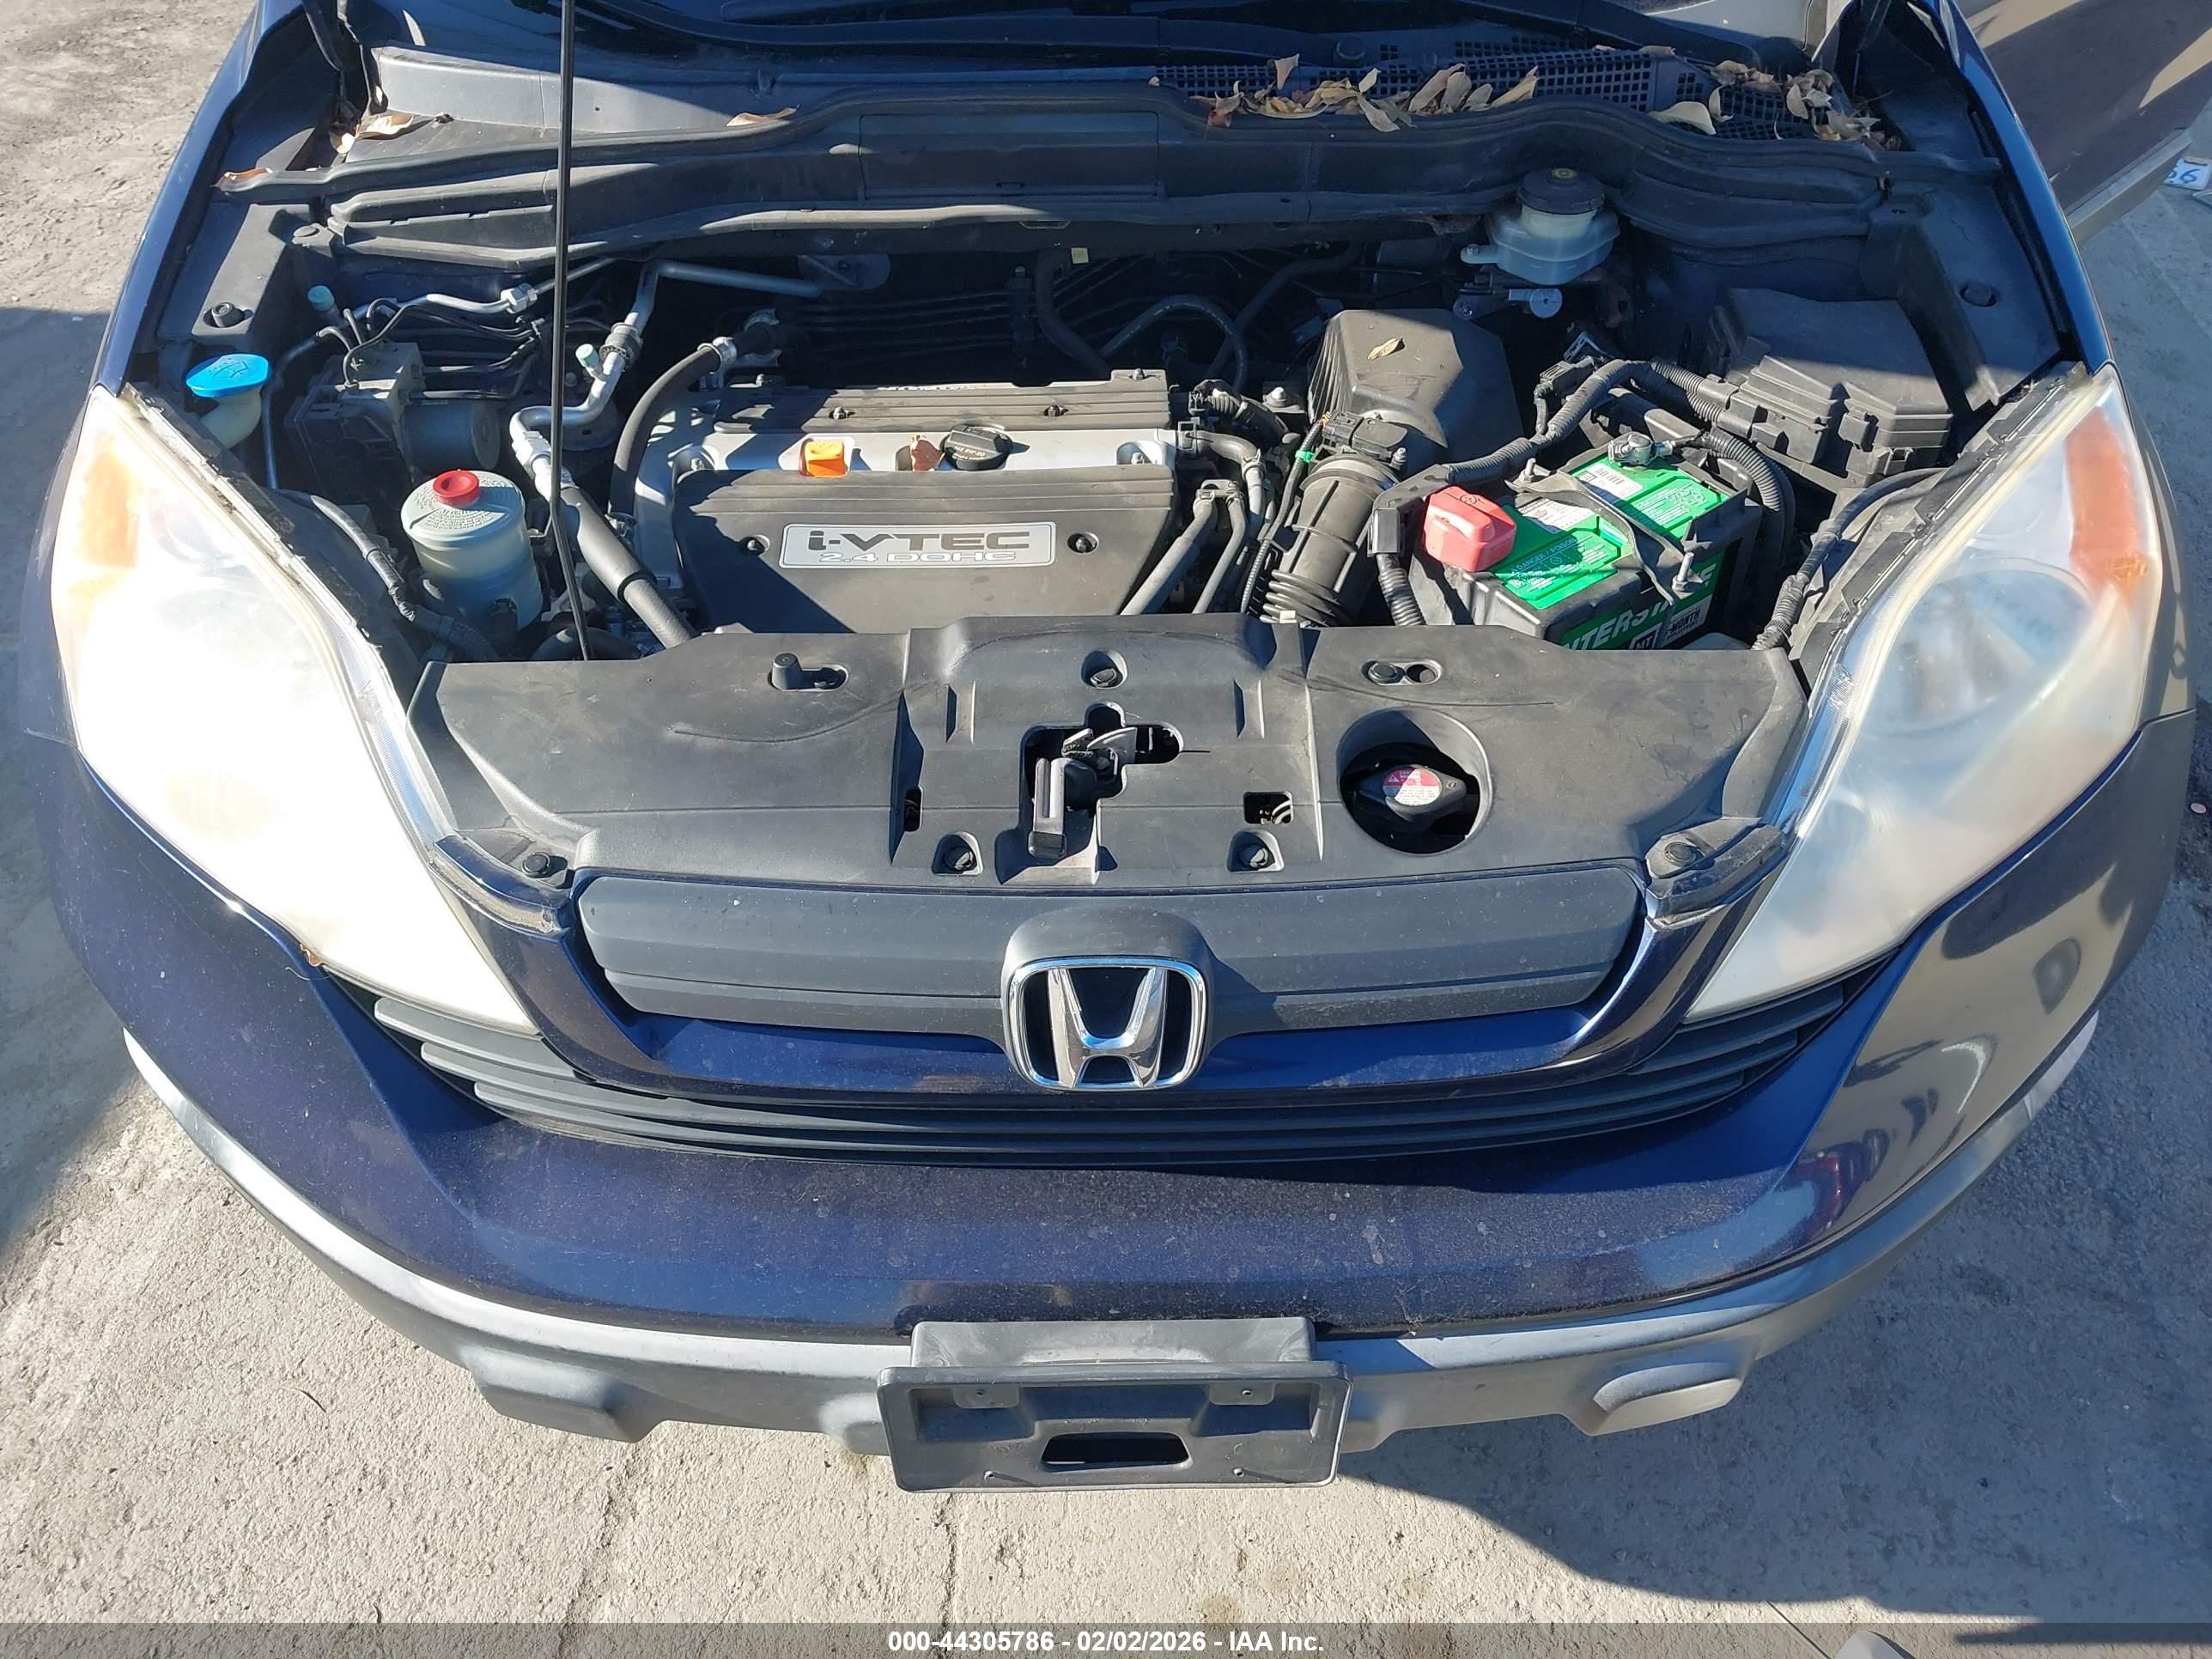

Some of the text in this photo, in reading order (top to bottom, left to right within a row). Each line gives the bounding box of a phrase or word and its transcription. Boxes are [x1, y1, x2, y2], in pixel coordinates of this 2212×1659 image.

[808, 530, 1030, 551] i-VTEC
[819, 551, 1017, 562] 2.4 DOHC
[1516, 553, 1546, 570] DANGER
[1549, 538, 1577, 552] POISON
